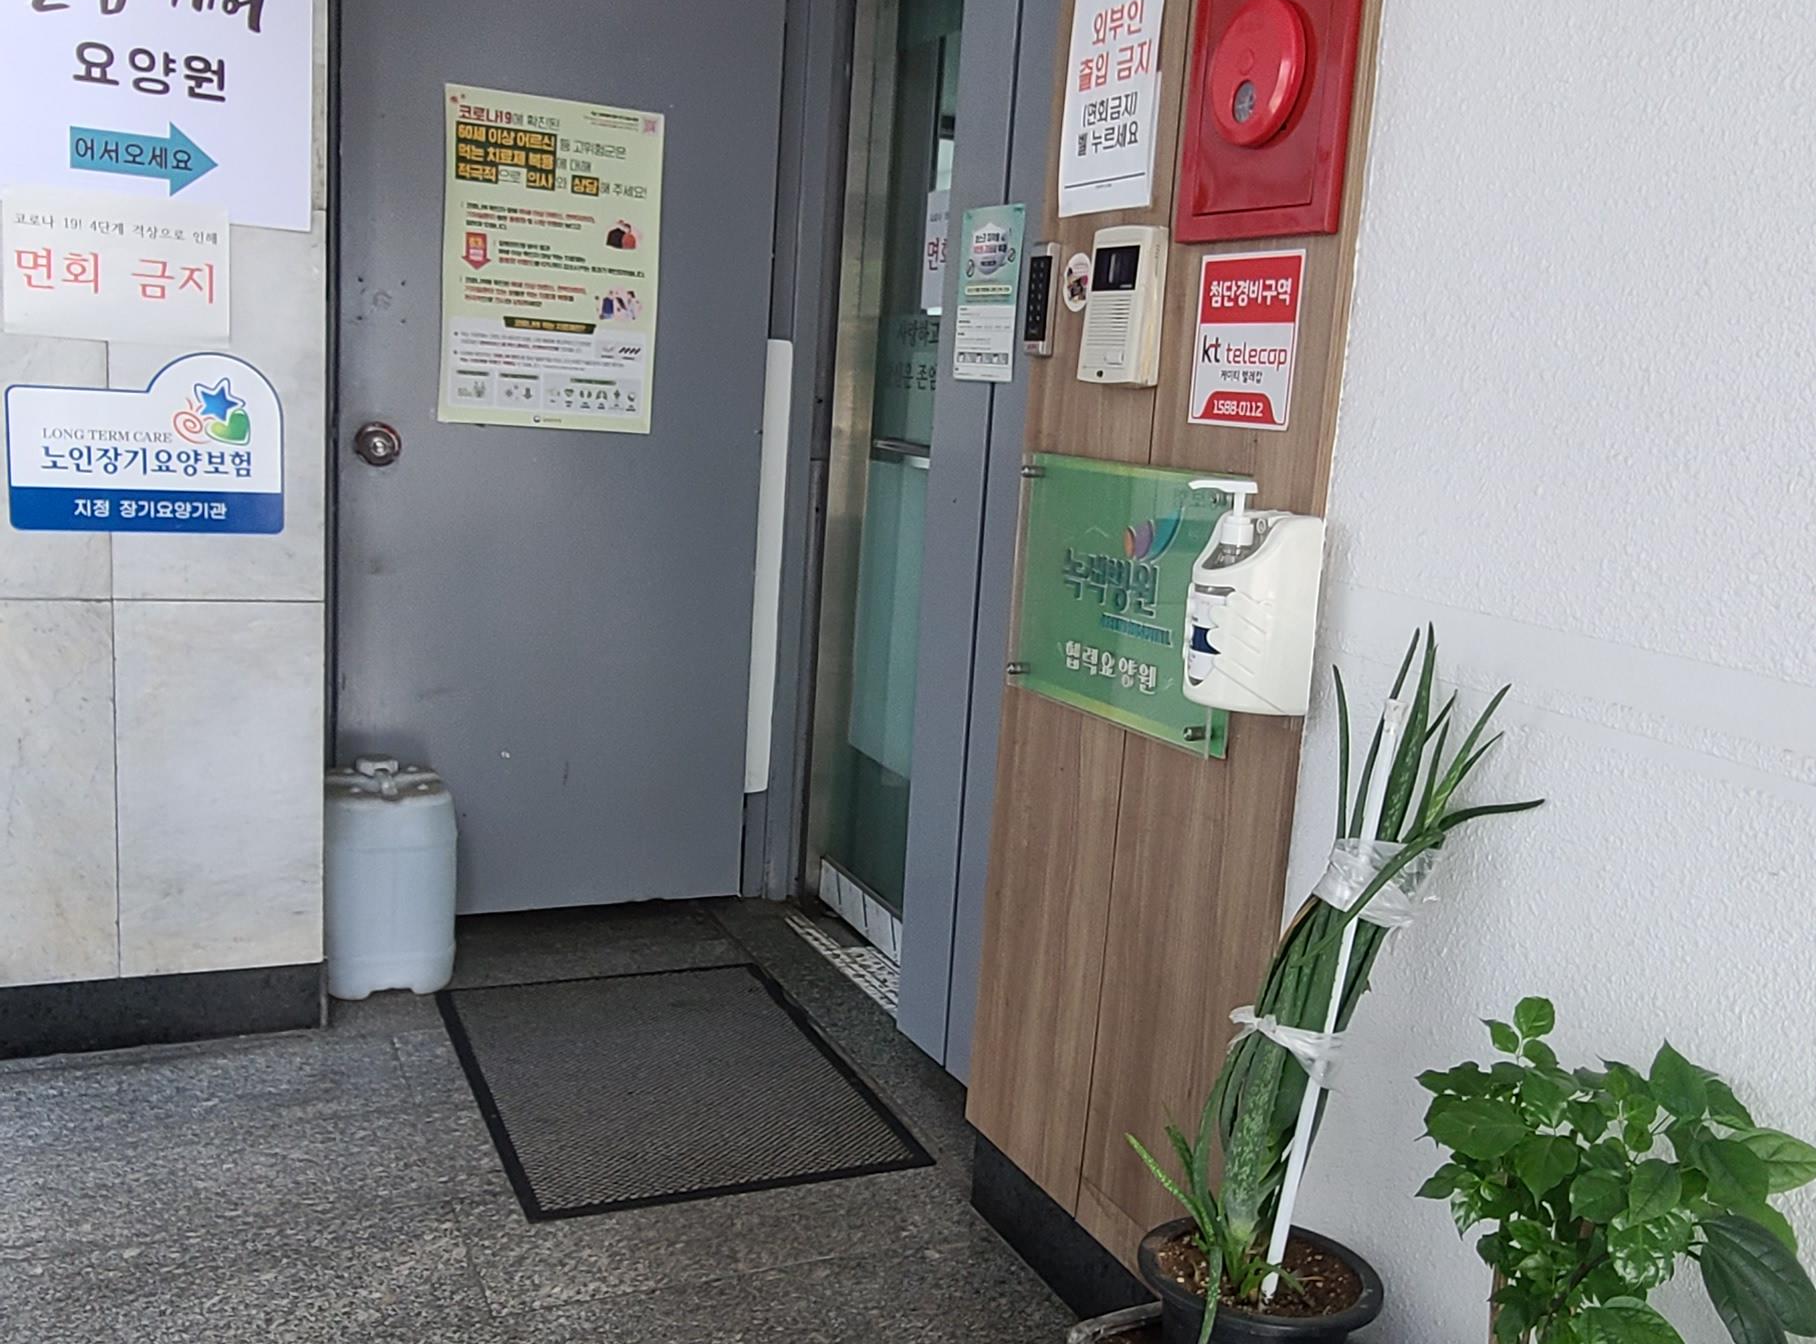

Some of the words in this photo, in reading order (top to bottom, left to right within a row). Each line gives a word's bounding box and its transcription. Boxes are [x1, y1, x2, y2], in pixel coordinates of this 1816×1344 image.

[72, 41, 226, 102] 요양원
[1078, 51, 1109, 92] 출입
[1116, 38, 1152, 81] 금지
[458, 124, 486, 142] 60세
[488, 128, 514, 146] 이상
[516, 131, 555, 151] 어르신
[1091, 120, 1138, 154] 누르세요
[74, 137, 193, 172] 어서오세요
[14, 212, 54, 228] 코로나
[89, 221, 124, 235] 4단계
[15, 247, 100, 294] 면회
[132, 258, 215, 304] 금지
[1209, 277, 1293, 307] 첨단경비구역
[1202, 335, 1221, 364] kt
[1226, 342, 1288, 371] telecop
[1212, 399, 1264, 417] 1588-0112
[42, 427, 86, 441] LONG
[89, 429, 131, 443] TERM
[133, 431, 173, 444] CARE
[41, 446, 252, 478] 노인장기요양보험
[74, 499, 110, 517] 지정
[119, 501, 228, 520] 장기요양기관
